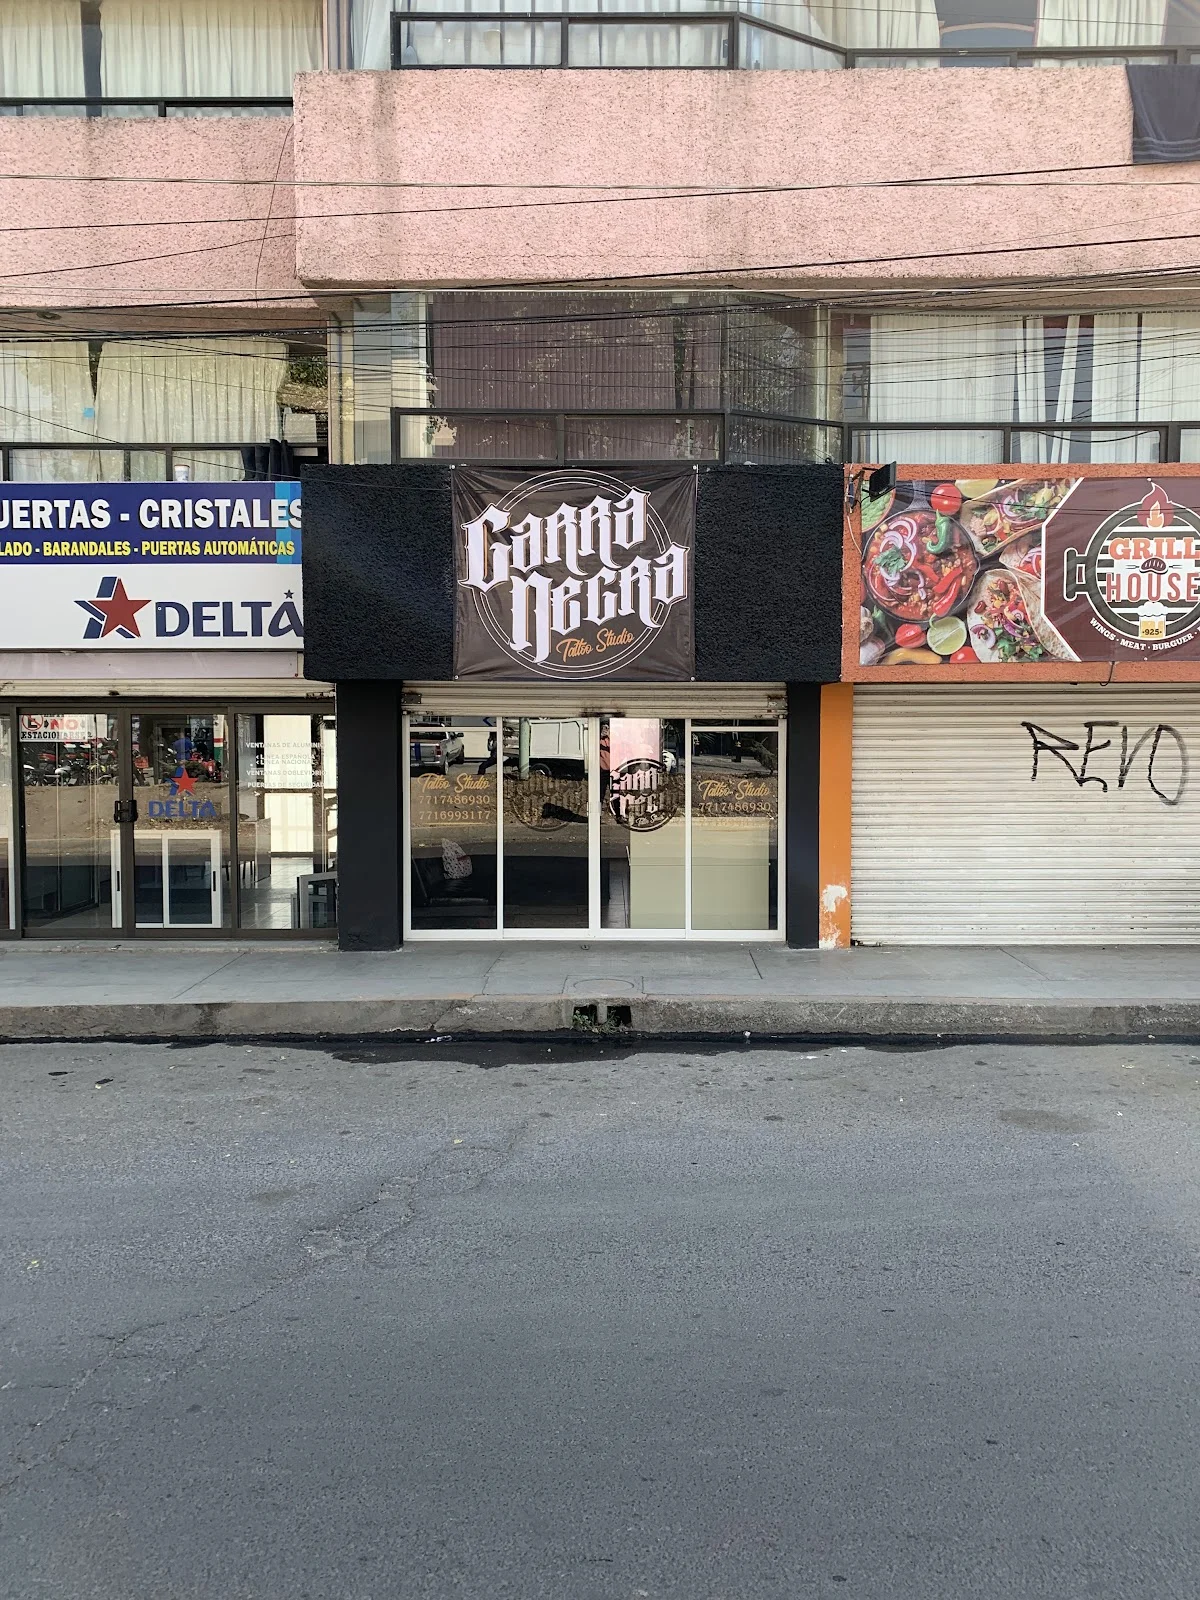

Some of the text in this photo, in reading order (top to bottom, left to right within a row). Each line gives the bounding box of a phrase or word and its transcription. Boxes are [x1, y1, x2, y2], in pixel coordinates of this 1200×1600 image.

[43, 541, 131, 556] BARANDALES
[141, 541, 201, 556] PUERTAS
[203, 537, 296, 556] AUTOMÁTICAS
[1108, 537, 1200, 560] GRILL
[1105, 571, 1200, 602] HOUSE
[155, 601, 304, 638] DELTA
[595, 628, 635, 653] Studio
[1089, 617, 1195, 651] WINGS MEAT BURGUER
[454, 772, 490, 793] Studio
[735, 780, 771, 800] Studio
[148, 800, 217, 817] DELTA
[419, 795, 490, 806] 7717486930
[419, 810, 491, 821] 7716993117
